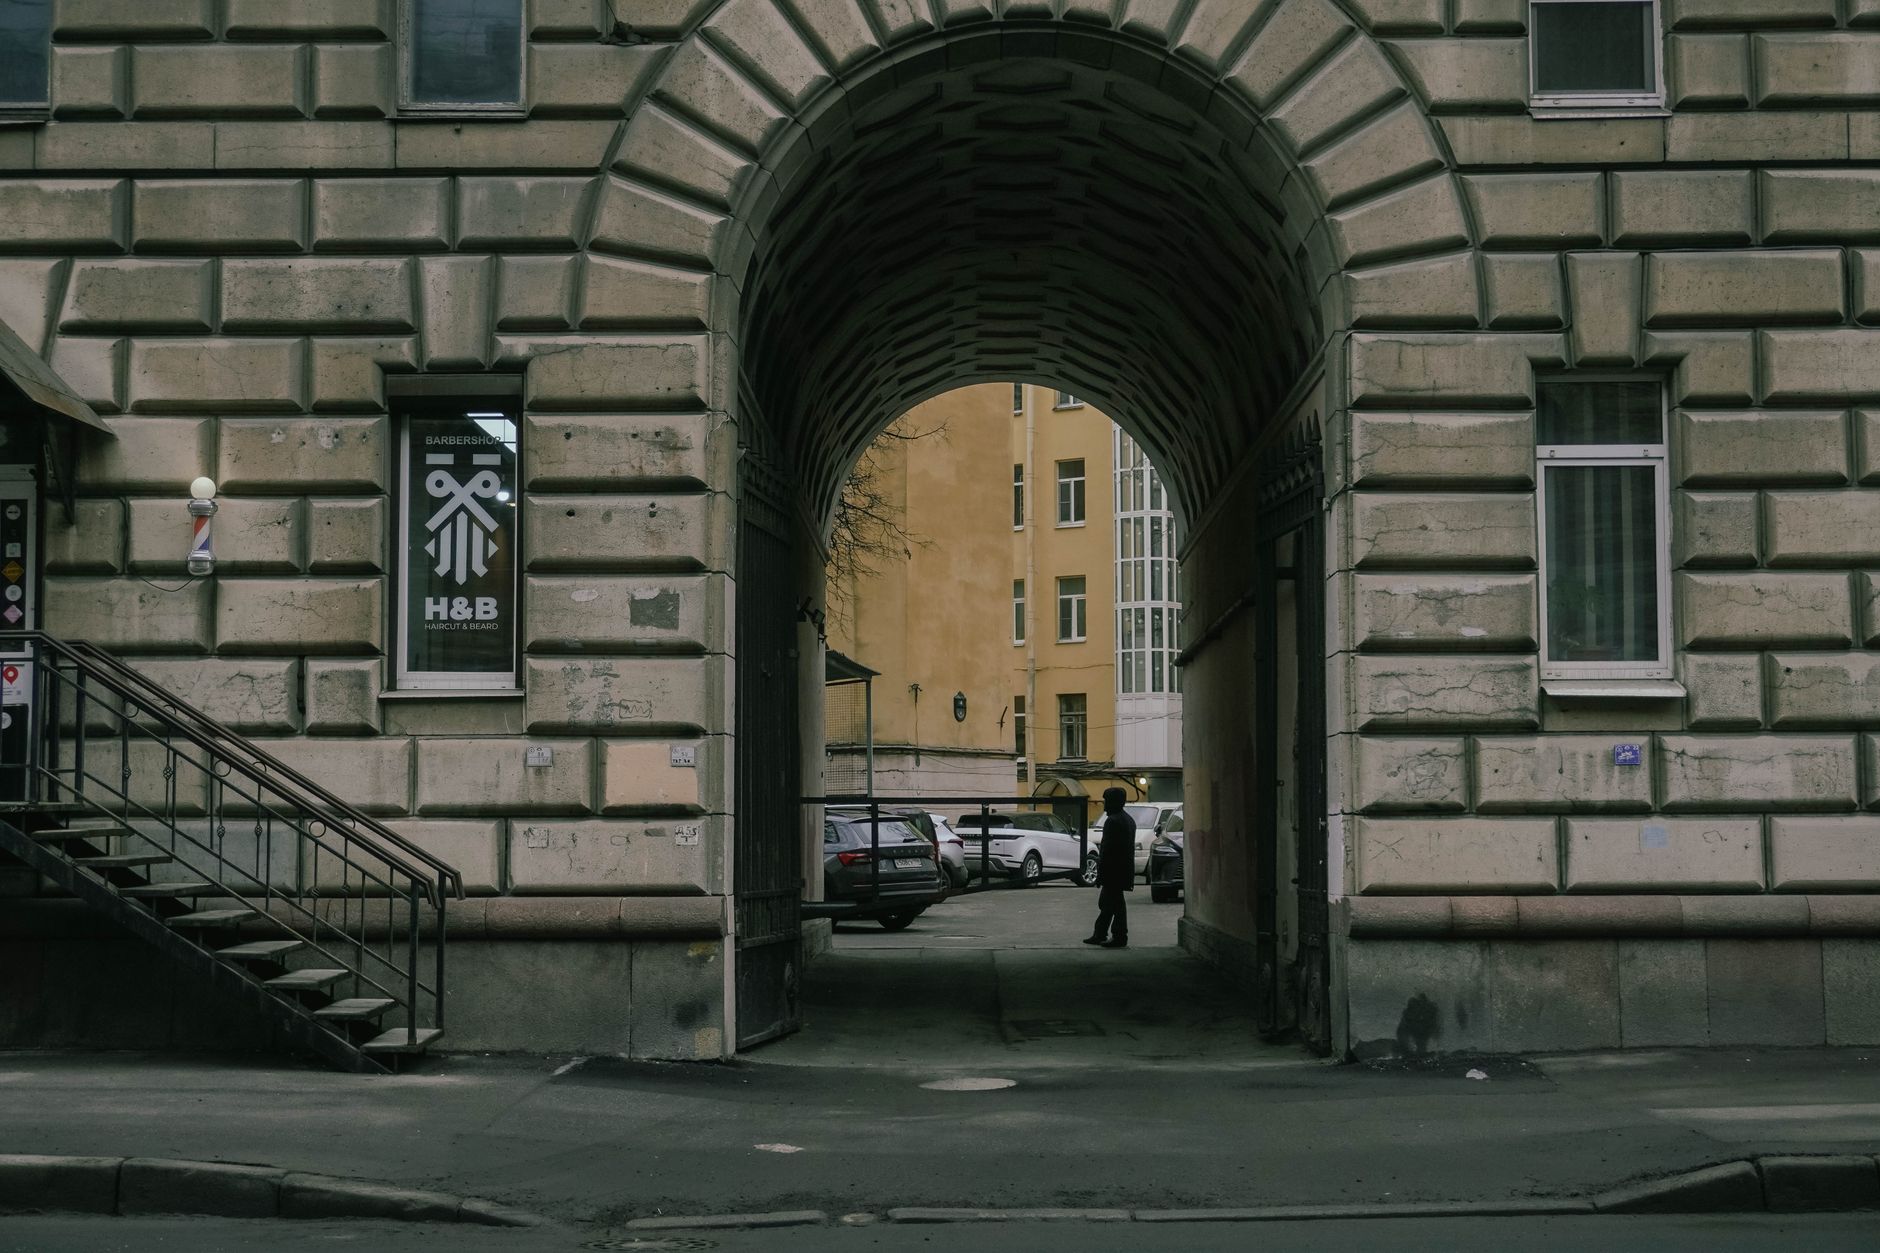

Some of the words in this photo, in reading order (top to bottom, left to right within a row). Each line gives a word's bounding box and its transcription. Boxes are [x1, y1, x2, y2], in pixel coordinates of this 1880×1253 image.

[425, 435, 501, 445] BARBERSHOP
[425, 596, 499, 621] H&B
[424, 622, 461, 630] HAIRCUT
[462, 622, 468, 630] &
[469, 622, 499, 630] BEARD
